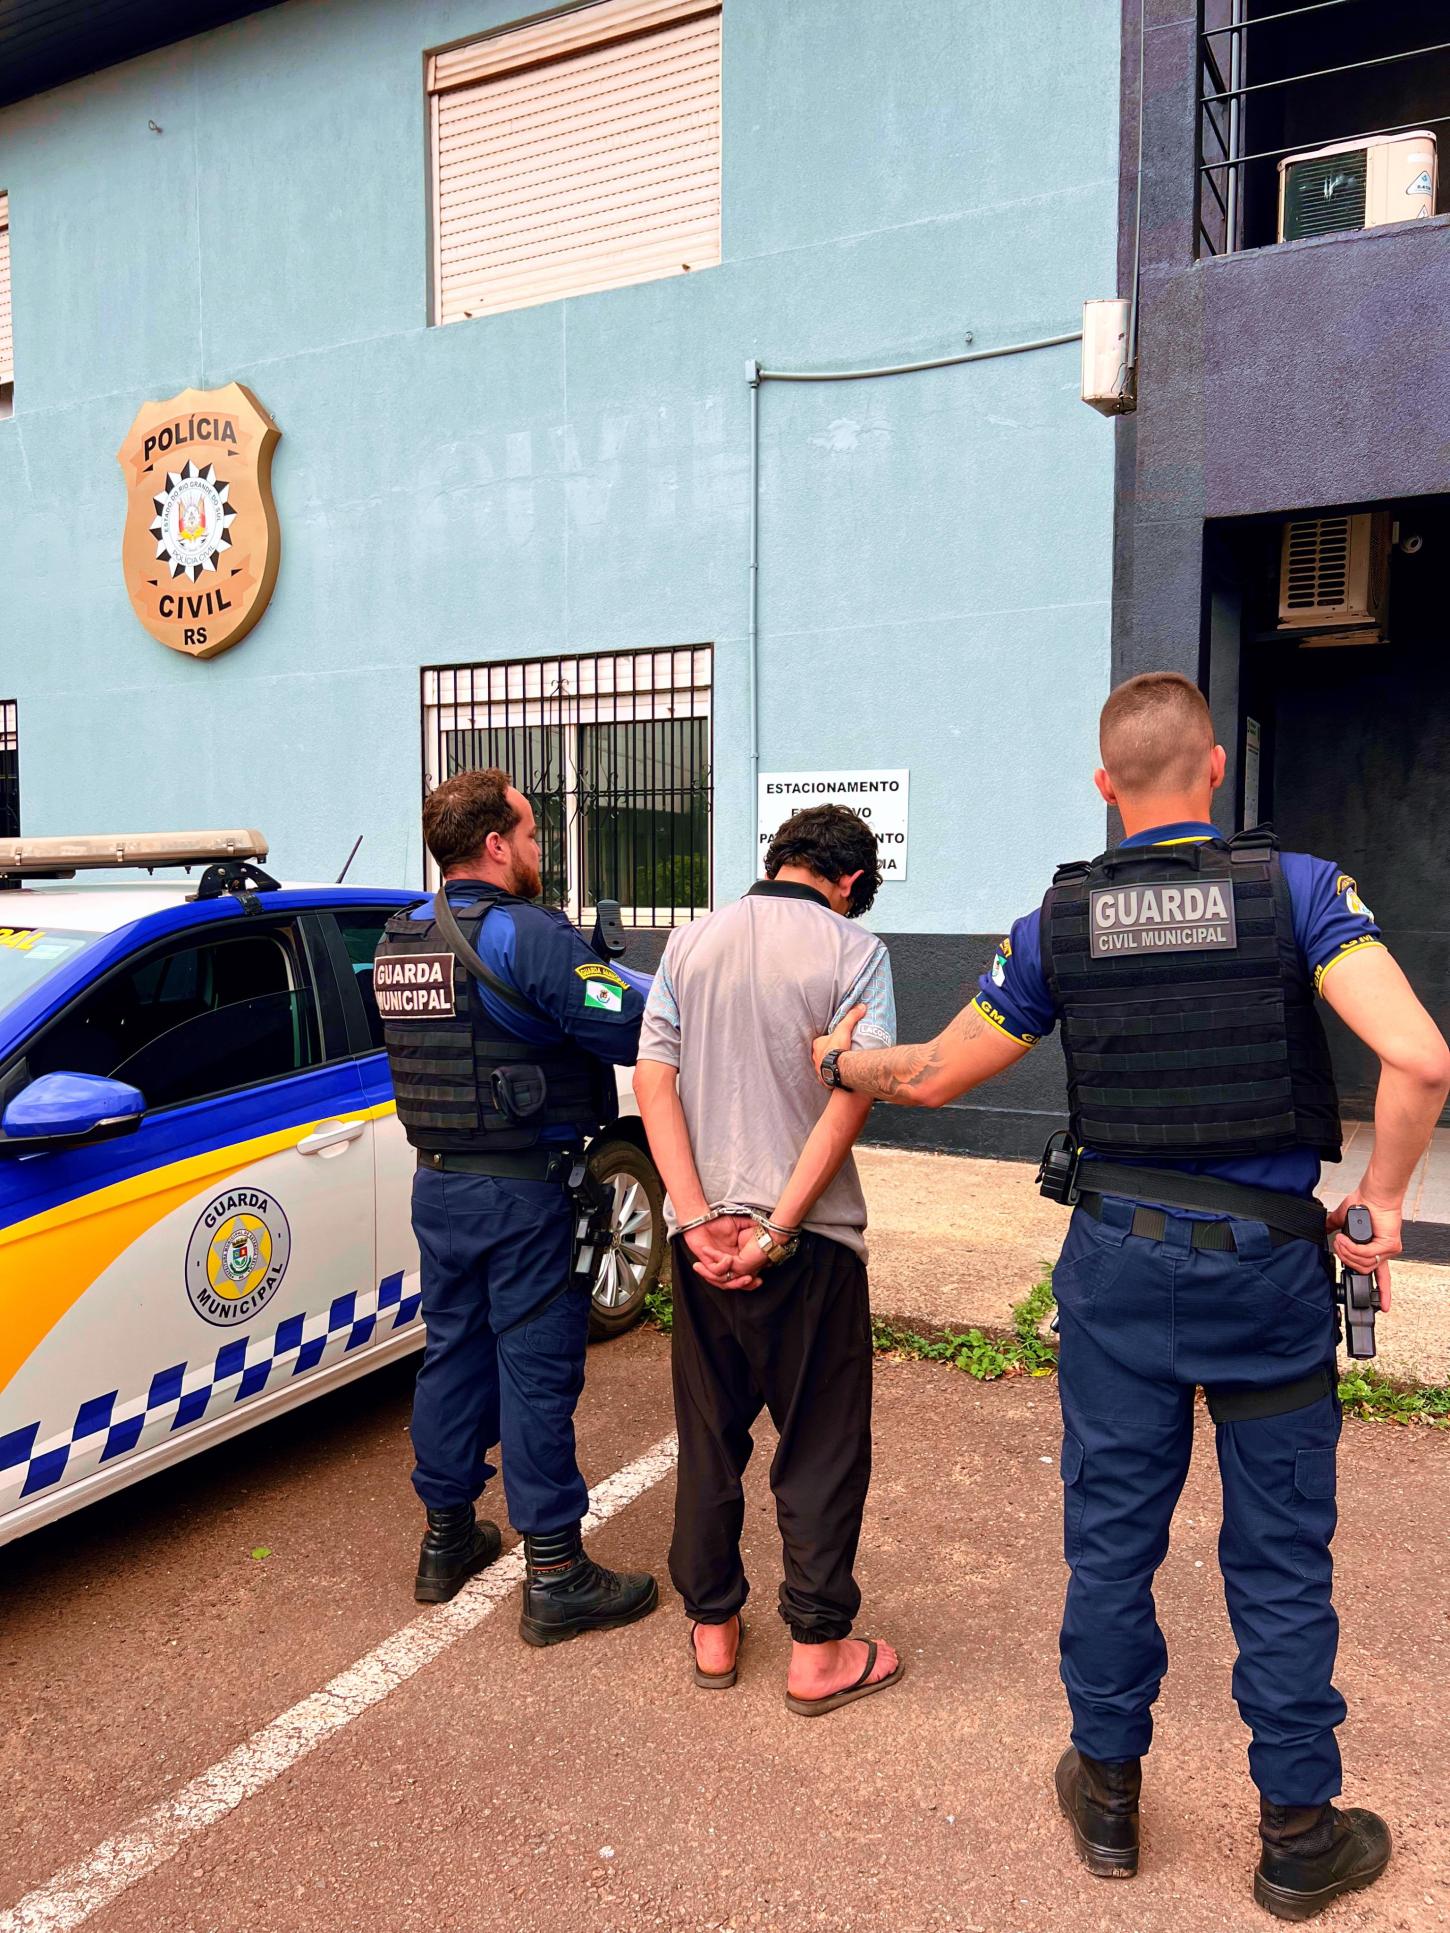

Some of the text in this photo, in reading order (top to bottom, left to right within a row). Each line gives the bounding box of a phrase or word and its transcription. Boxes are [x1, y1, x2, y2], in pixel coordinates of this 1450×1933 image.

[144, 413, 237, 462] POLÍCIA
[164, 502, 173, 533] ESTADO
[170, 491, 179, 501] DO
[178, 483, 189, 492] RIO
[189, 481, 212, 495] GRANDE
[198, 545, 215, 561] CIVIL
[158, 588, 232, 619] CIVIL
[184, 627, 208, 646] RS
[766, 780, 900, 794] ESTACIONAMENTO
[1095, 886, 1228, 928] GUARDA
[1098, 927, 1227, 951] CIVIL MUNICIPAL
[377, 962, 444, 985] GUARDA
[375, 989, 451, 1011] MUNICIPAL
[981, 1001, 1006, 1025] GM
[204, 1192, 269, 1229] GUARDA
[196, 1263, 284, 1319] MUNICIPAL
